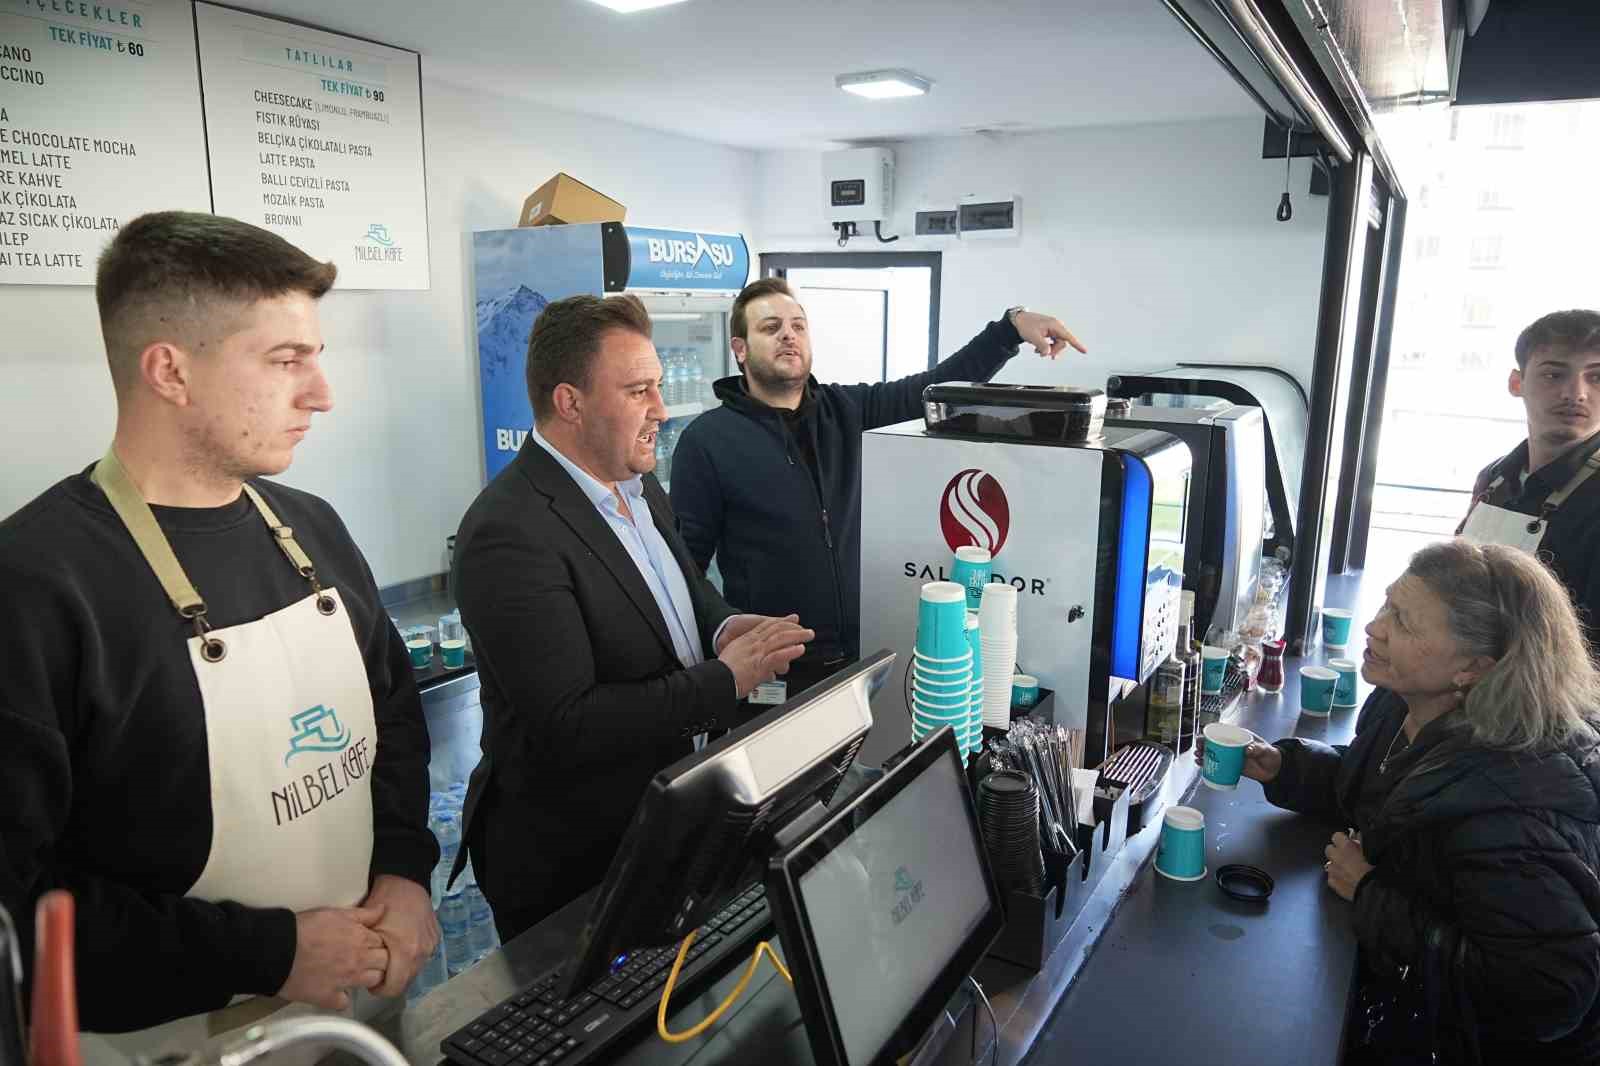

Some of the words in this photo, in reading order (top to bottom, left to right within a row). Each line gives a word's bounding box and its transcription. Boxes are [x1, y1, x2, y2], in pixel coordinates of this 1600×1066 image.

[25, 0, 143, 28] ÇECEKLER
[49, 26, 76, 44] TEK
[79, 31, 112, 51] FİYAT
[286, 48, 352, 72] TATLILAR
[0, 65, 45, 86] CCINO
[320, 79, 338, 92] TEK
[254, 90, 313, 111] CHEESECAKE
[256, 111, 287, 127] FISTIK
[289, 116, 321, 132] RÜYASI
[12, 129, 89, 151] CHOCOLATE
[93, 139, 137, 157] MOCHA
[257, 131, 297, 149] BELÇİKA
[299, 135, 347, 154] ÇİKOLATALI
[349, 143, 373, 157] PASTA
[1, 150, 28, 166] MEL
[32, 152, 72, 169] LATTE
[259, 152, 287, 167] LATTE
[290, 155, 315, 169] PASTA
[19, 171, 62, 189] KAHVE
[261, 172, 287, 187] BALLI
[290, 175, 324, 190] CEVİZLİ
[326, 179, 350, 193] PASTA
[0, 191, 12, 205] K
[16, 190, 77, 209] ÇİKOLATA
[263, 192, 297, 208] MOZAİK
[299, 195, 325, 209] PASTA
[19, 212, 59, 229] SICAK
[62, 213, 120, 232] ÇİKOLATA
[265, 213, 303, 227] BROWNI
[16, 252, 41, 267] TEA
[44, 254, 83, 268] LATTE
[904, 562, 1046, 596] SALDOR
[340, 736, 370, 787] KAFE
